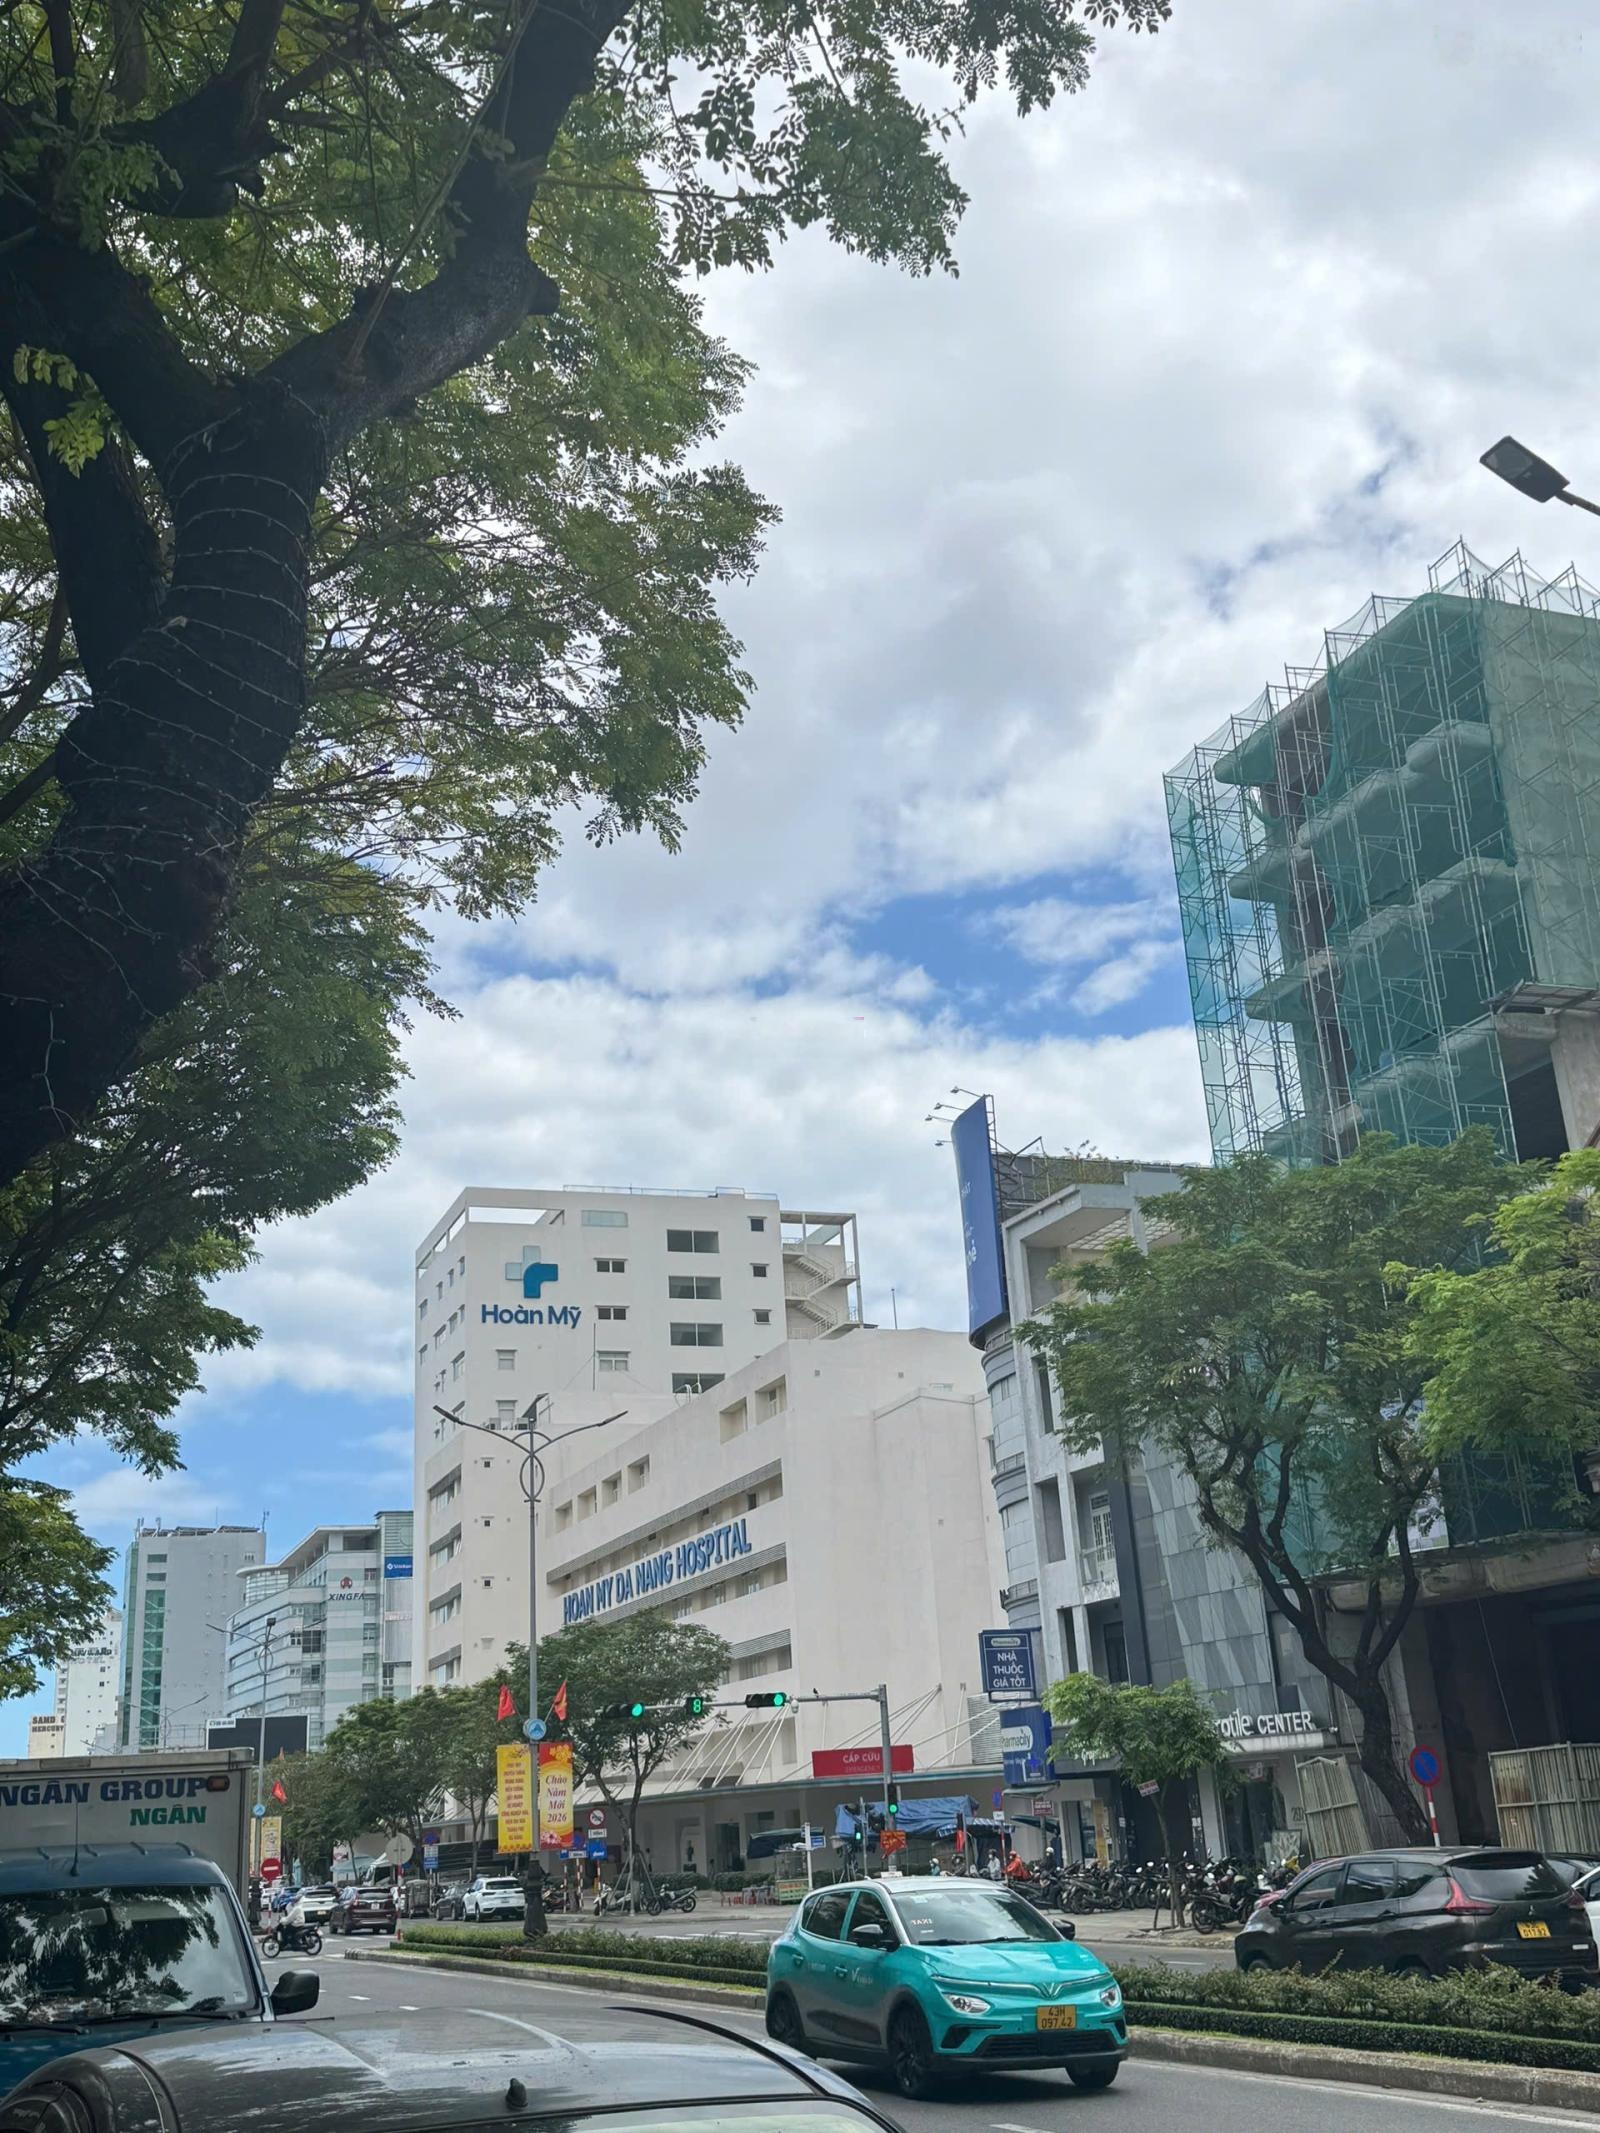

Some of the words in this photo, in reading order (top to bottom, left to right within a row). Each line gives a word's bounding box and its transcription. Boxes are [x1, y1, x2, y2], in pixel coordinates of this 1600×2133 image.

[481, 1304, 543, 1324] Hoàn
[548, 1305, 582, 1329] Mỹ
[563, 1585, 594, 1625] HOAN
[596, 1576, 613, 1611] MY
[616, 1569, 634, 1603] DA
[635, 1551, 673, 1596] NANG
[676, 1518, 752, 1580] HOSPITAL
[997, 1650, 1017, 1661] NHÀ
[992, 1661, 1024, 1674] THUỐC
[993, 1676, 1008, 1688] GIÁ
[1010, 1674, 1026, 1687] TỐT
[693, 1698, 701, 1713] 8
[1257, 1711, 1313, 1735] CENTER
[0, 1781, 90, 1806] NGÂN
[100, 1777, 208, 1801] GROUP
[130, 1804, 207, 1826] NGÂN
[547, 1813, 567, 1823] 2026
